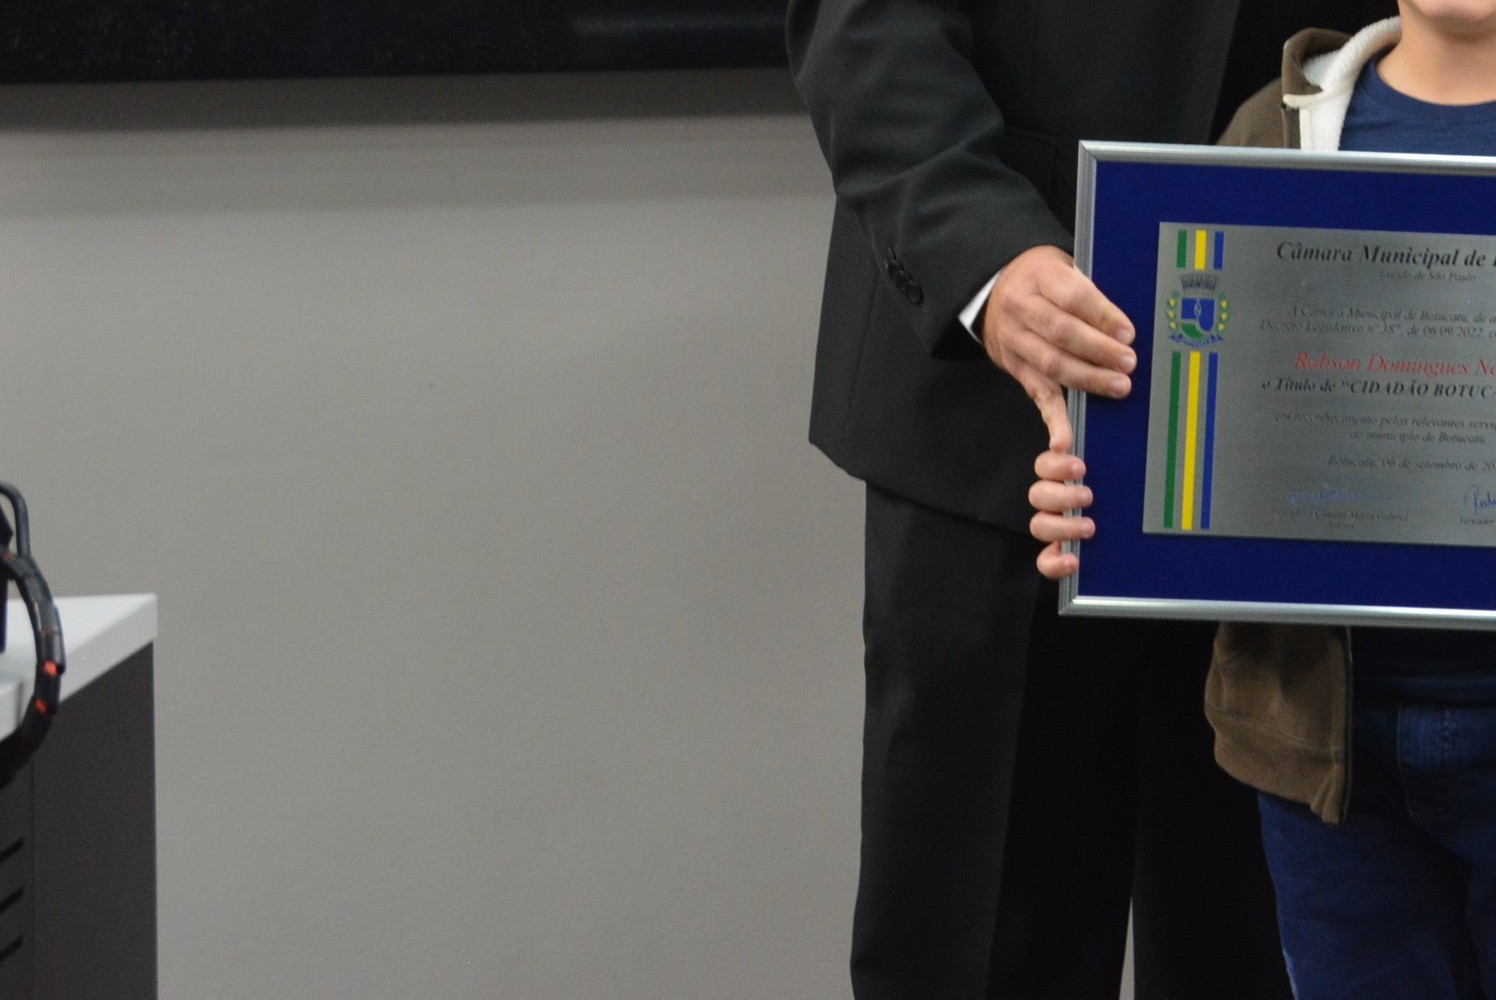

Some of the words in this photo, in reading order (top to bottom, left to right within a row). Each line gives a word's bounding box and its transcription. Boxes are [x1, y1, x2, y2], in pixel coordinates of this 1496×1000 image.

[1276, 241, 1353, 261] Câmara
[1359, 244, 1460, 269] Municipal
[1463, 249, 1487, 267] de
[1294, 351, 1362, 371] Robson
[1366, 353, 1469, 379] Domingues
[1319, 378, 1337, 394] de
